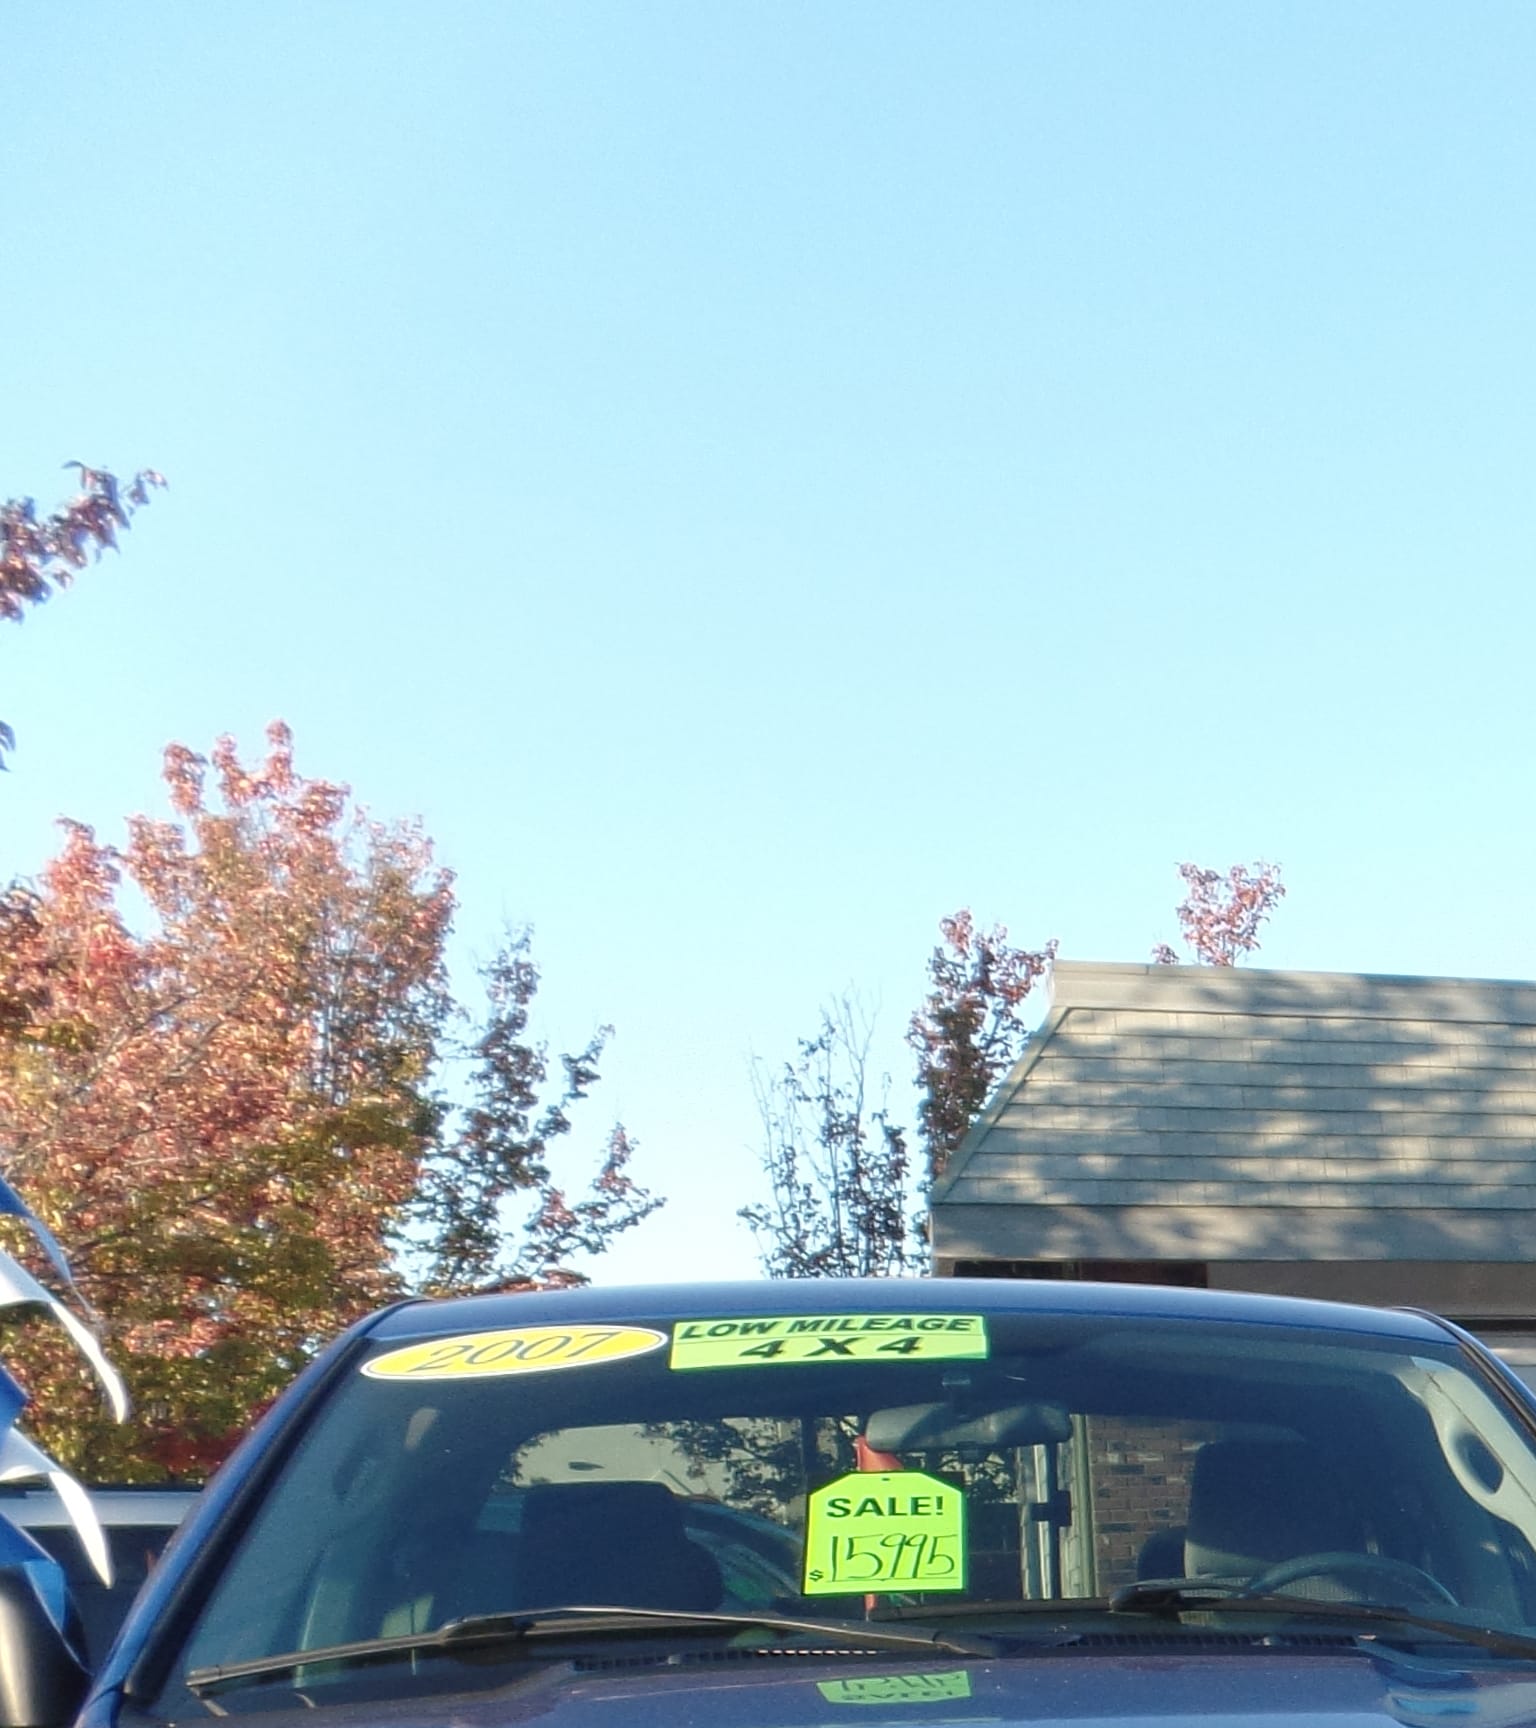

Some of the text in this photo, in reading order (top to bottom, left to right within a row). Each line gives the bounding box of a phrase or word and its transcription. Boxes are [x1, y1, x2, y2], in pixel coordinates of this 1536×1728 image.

[679, 1317, 976, 1340] LOW MILEAGE
[405, 1331, 623, 1373] 2007
[826, 1496, 943, 1518] SALE!
